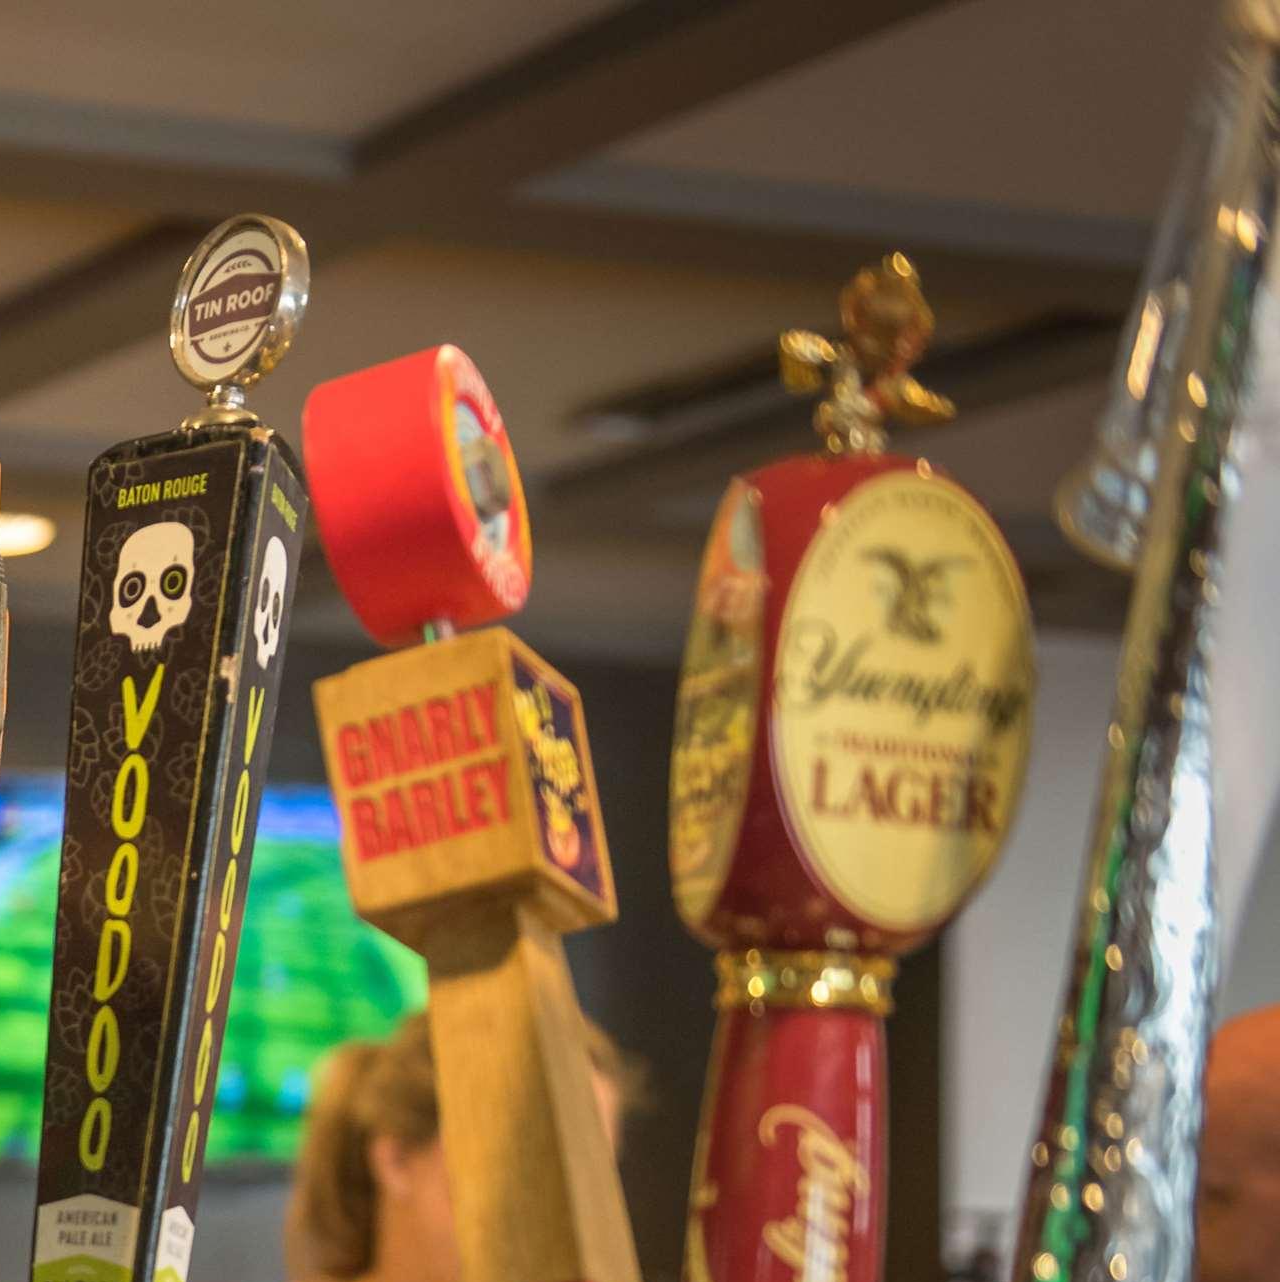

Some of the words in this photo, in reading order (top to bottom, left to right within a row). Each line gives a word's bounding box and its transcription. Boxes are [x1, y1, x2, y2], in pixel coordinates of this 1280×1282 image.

[194, 297, 223, 322] TIN
[226, 282, 275, 313] ROOF
[117, 481, 161, 510] BATON
[163, 472, 209, 499] ROUGE
[337, 681, 500, 790] GNARLY
[349, 753, 512, 863] BARLEY
[810, 758, 1001, 834] LAGER
[78, 662, 166, 1173] VOODOO
[181, 685, 266, 1185] VOODOO
[56, 1209, 119, 1227] AMERICAN
[58, 1230, 86, 1246] PALE
[89, 1231, 114, 1248] ALE
